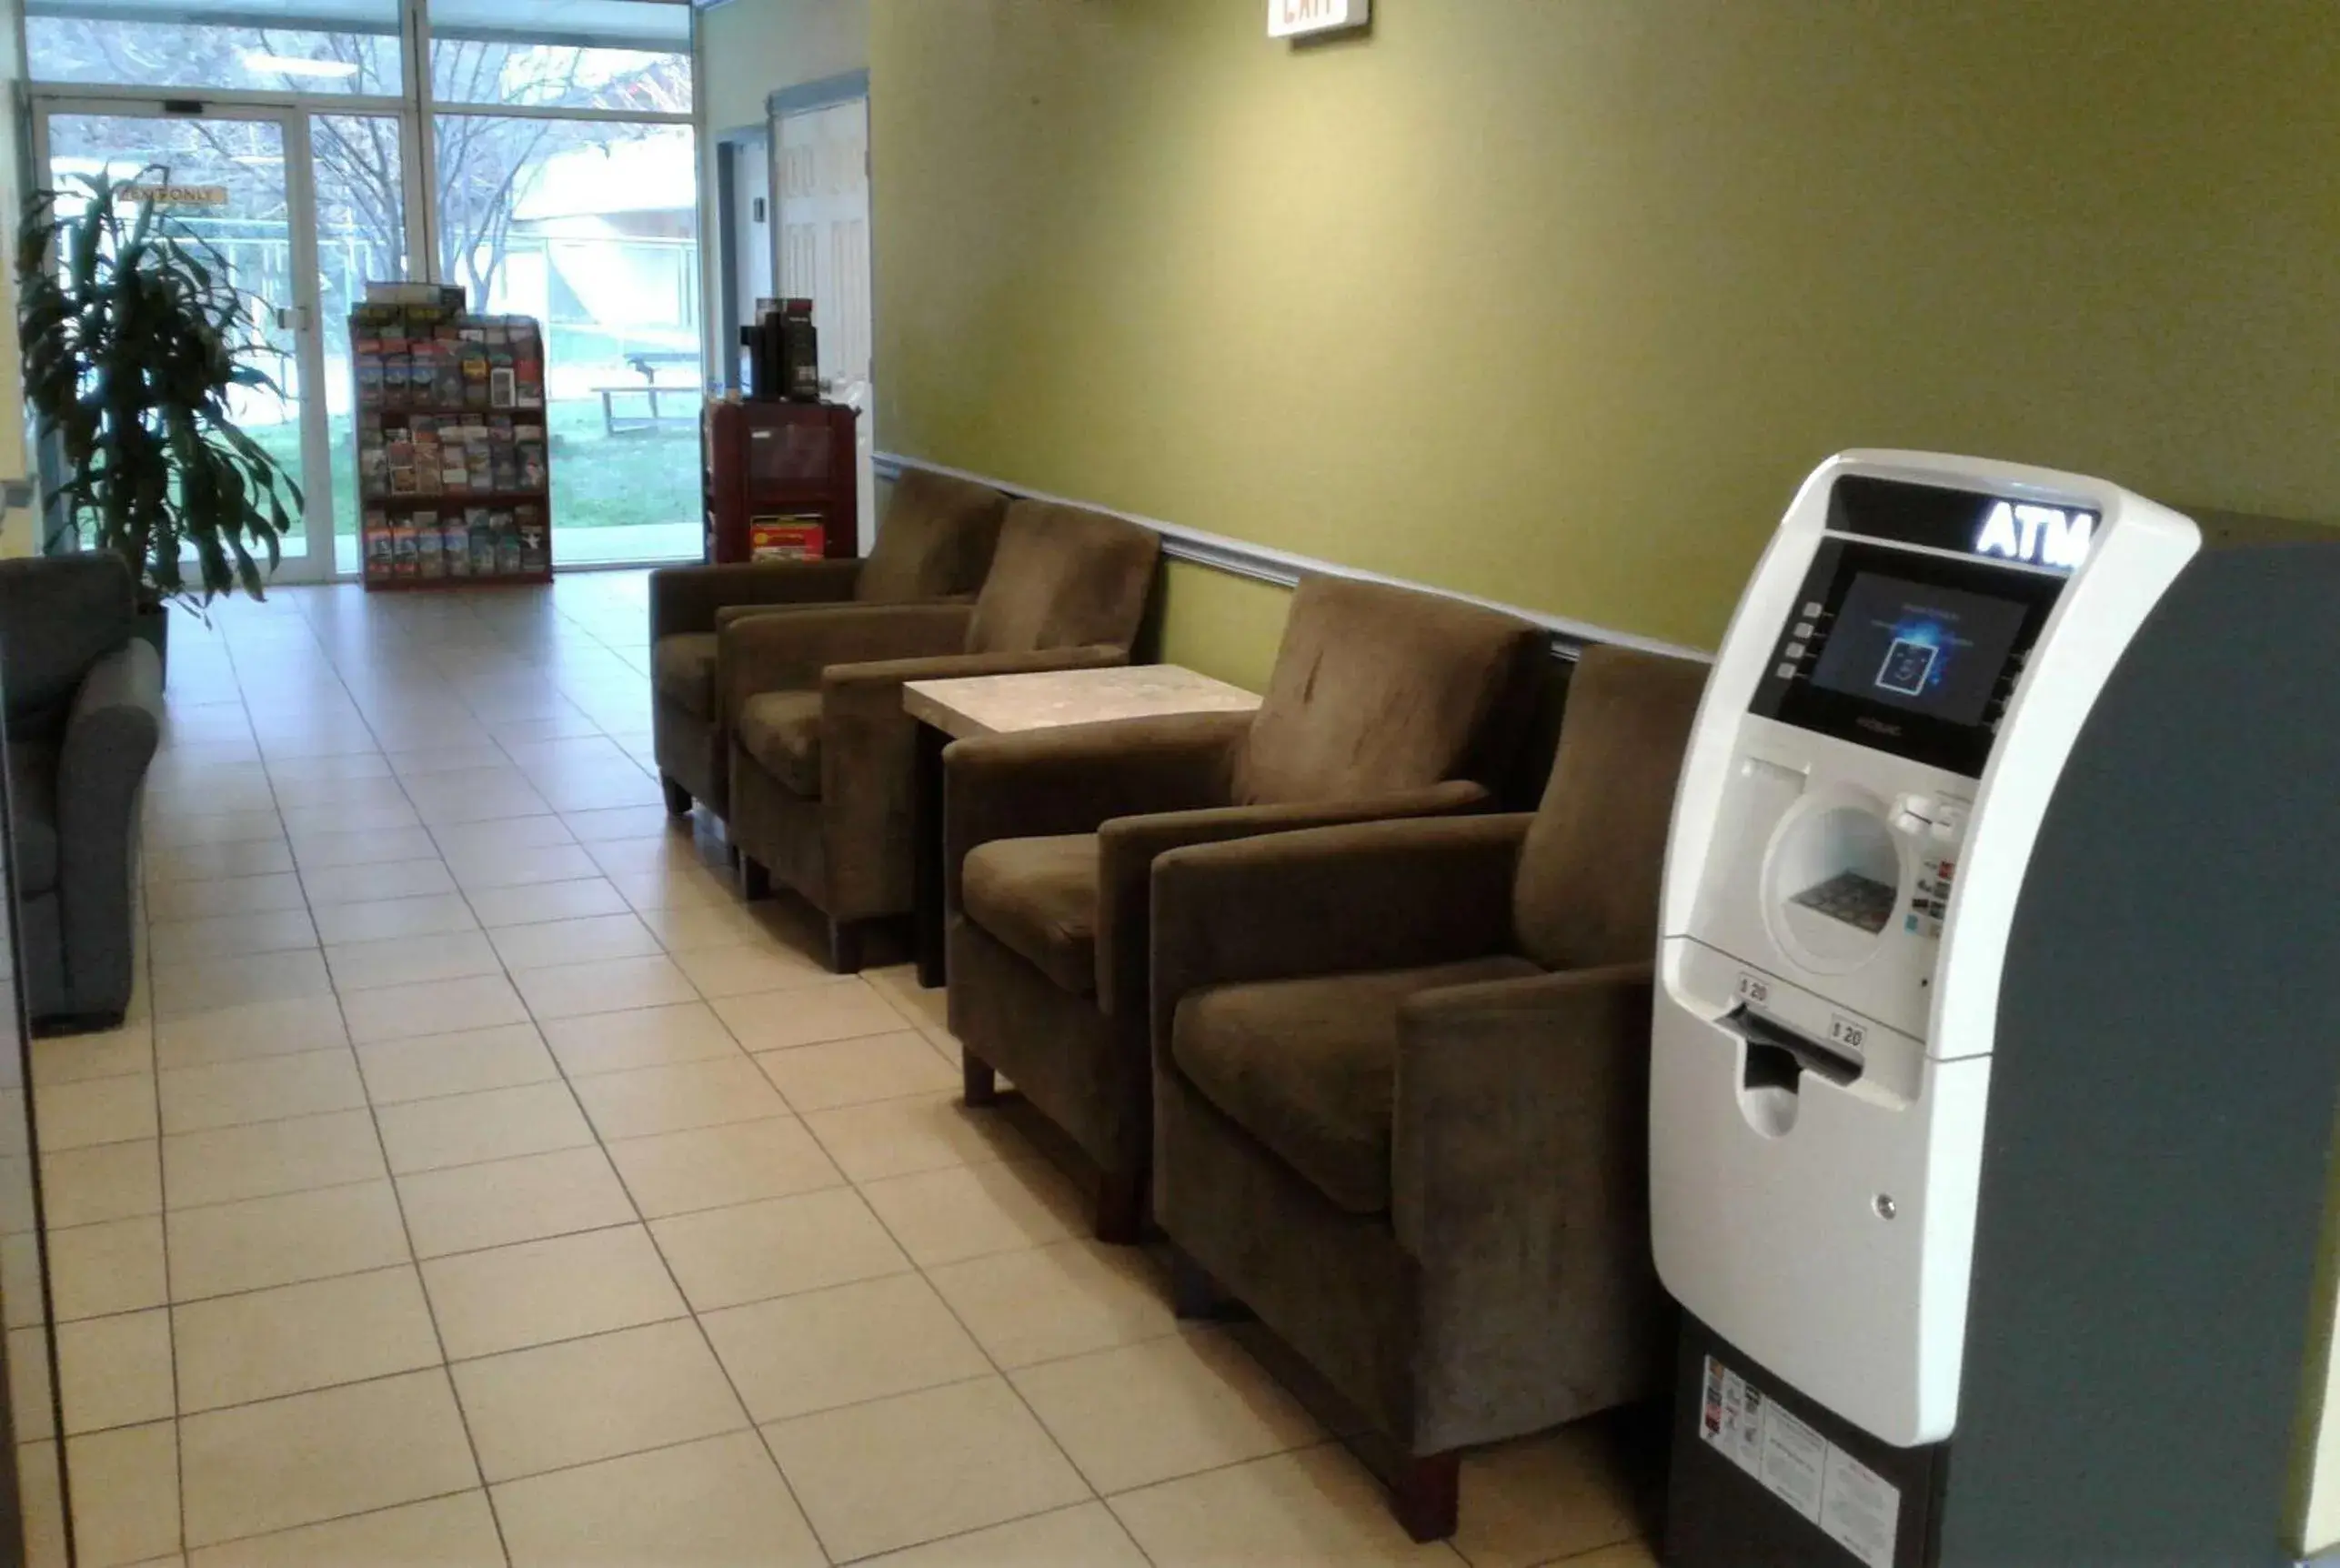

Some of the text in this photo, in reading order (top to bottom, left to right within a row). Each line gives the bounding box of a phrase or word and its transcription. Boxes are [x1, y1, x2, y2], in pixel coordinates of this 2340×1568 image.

[170, 188, 211, 200] ONLY
[1976, 501, 2093, 569] ATM
[1843, 1026, 1863, 1046] 20
